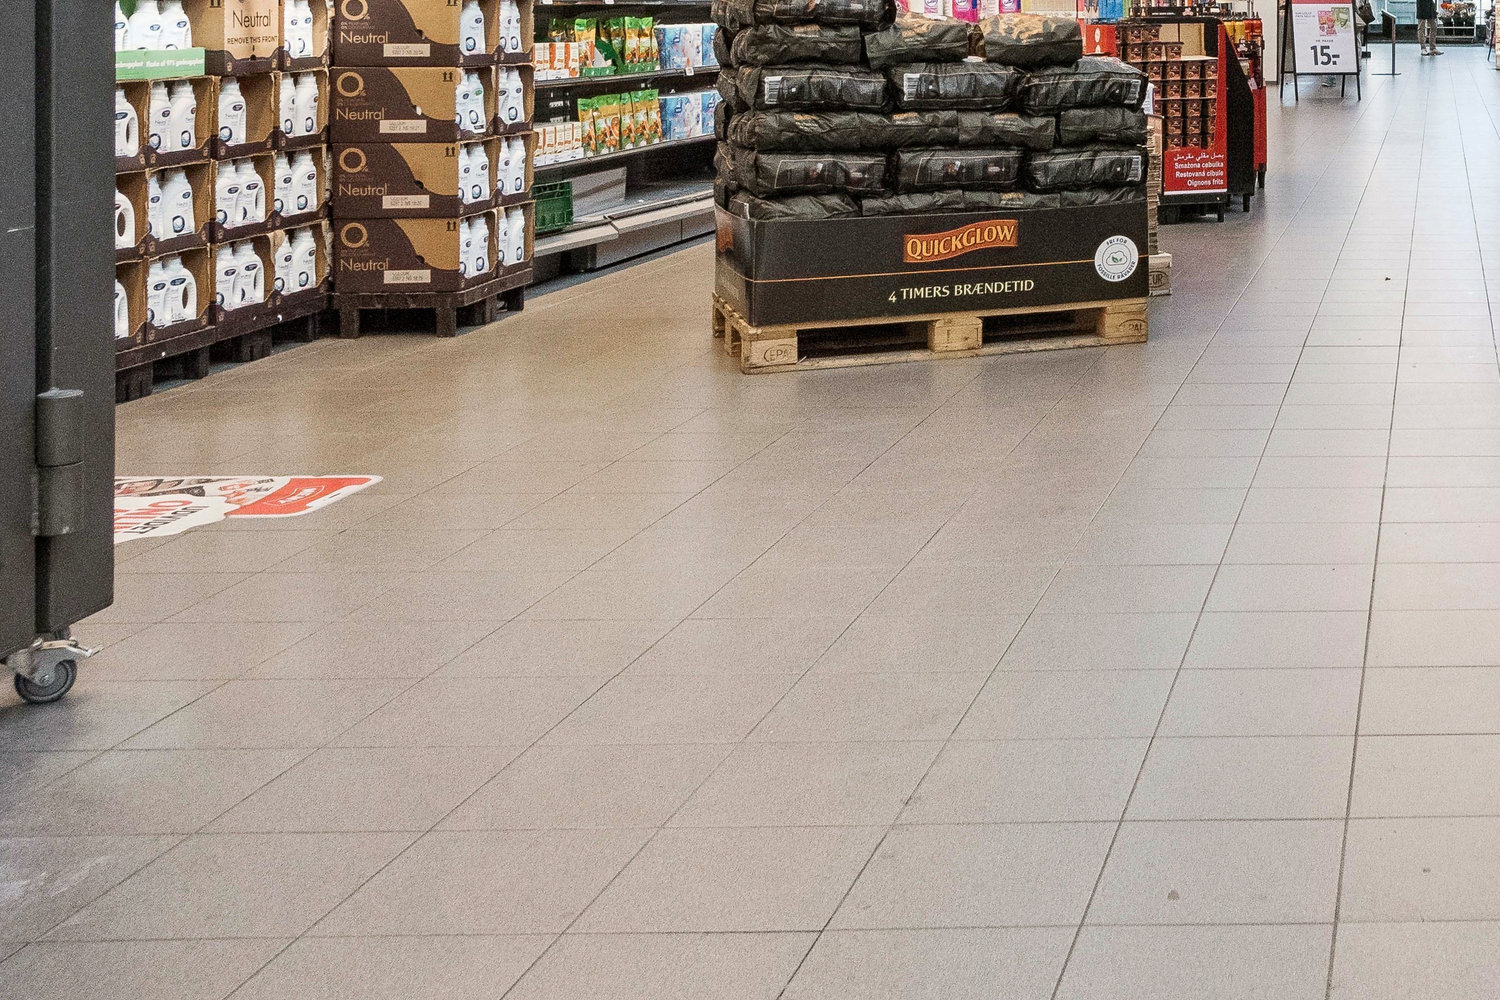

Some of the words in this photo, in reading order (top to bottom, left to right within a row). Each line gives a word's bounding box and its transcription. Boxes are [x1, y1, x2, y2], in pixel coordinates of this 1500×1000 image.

[232, 9, 272, 28] Neutral
[226, 36, 249, 45] REMOVE
[250, 36, 261, 44] THIS
[262, 35, 278, 44] FRONT
[340, 32, 390, 44] Neutral
[336, 108, 385, 120] Neutral
[338, 183, 388, 196] Neutral
[340, 258, 390, 272] Neutral
[888, 291, 897, 303] 4
[900, 284, 950, 300] TIMERS
[954, 279, 1034, 297] BRÆNDETID
